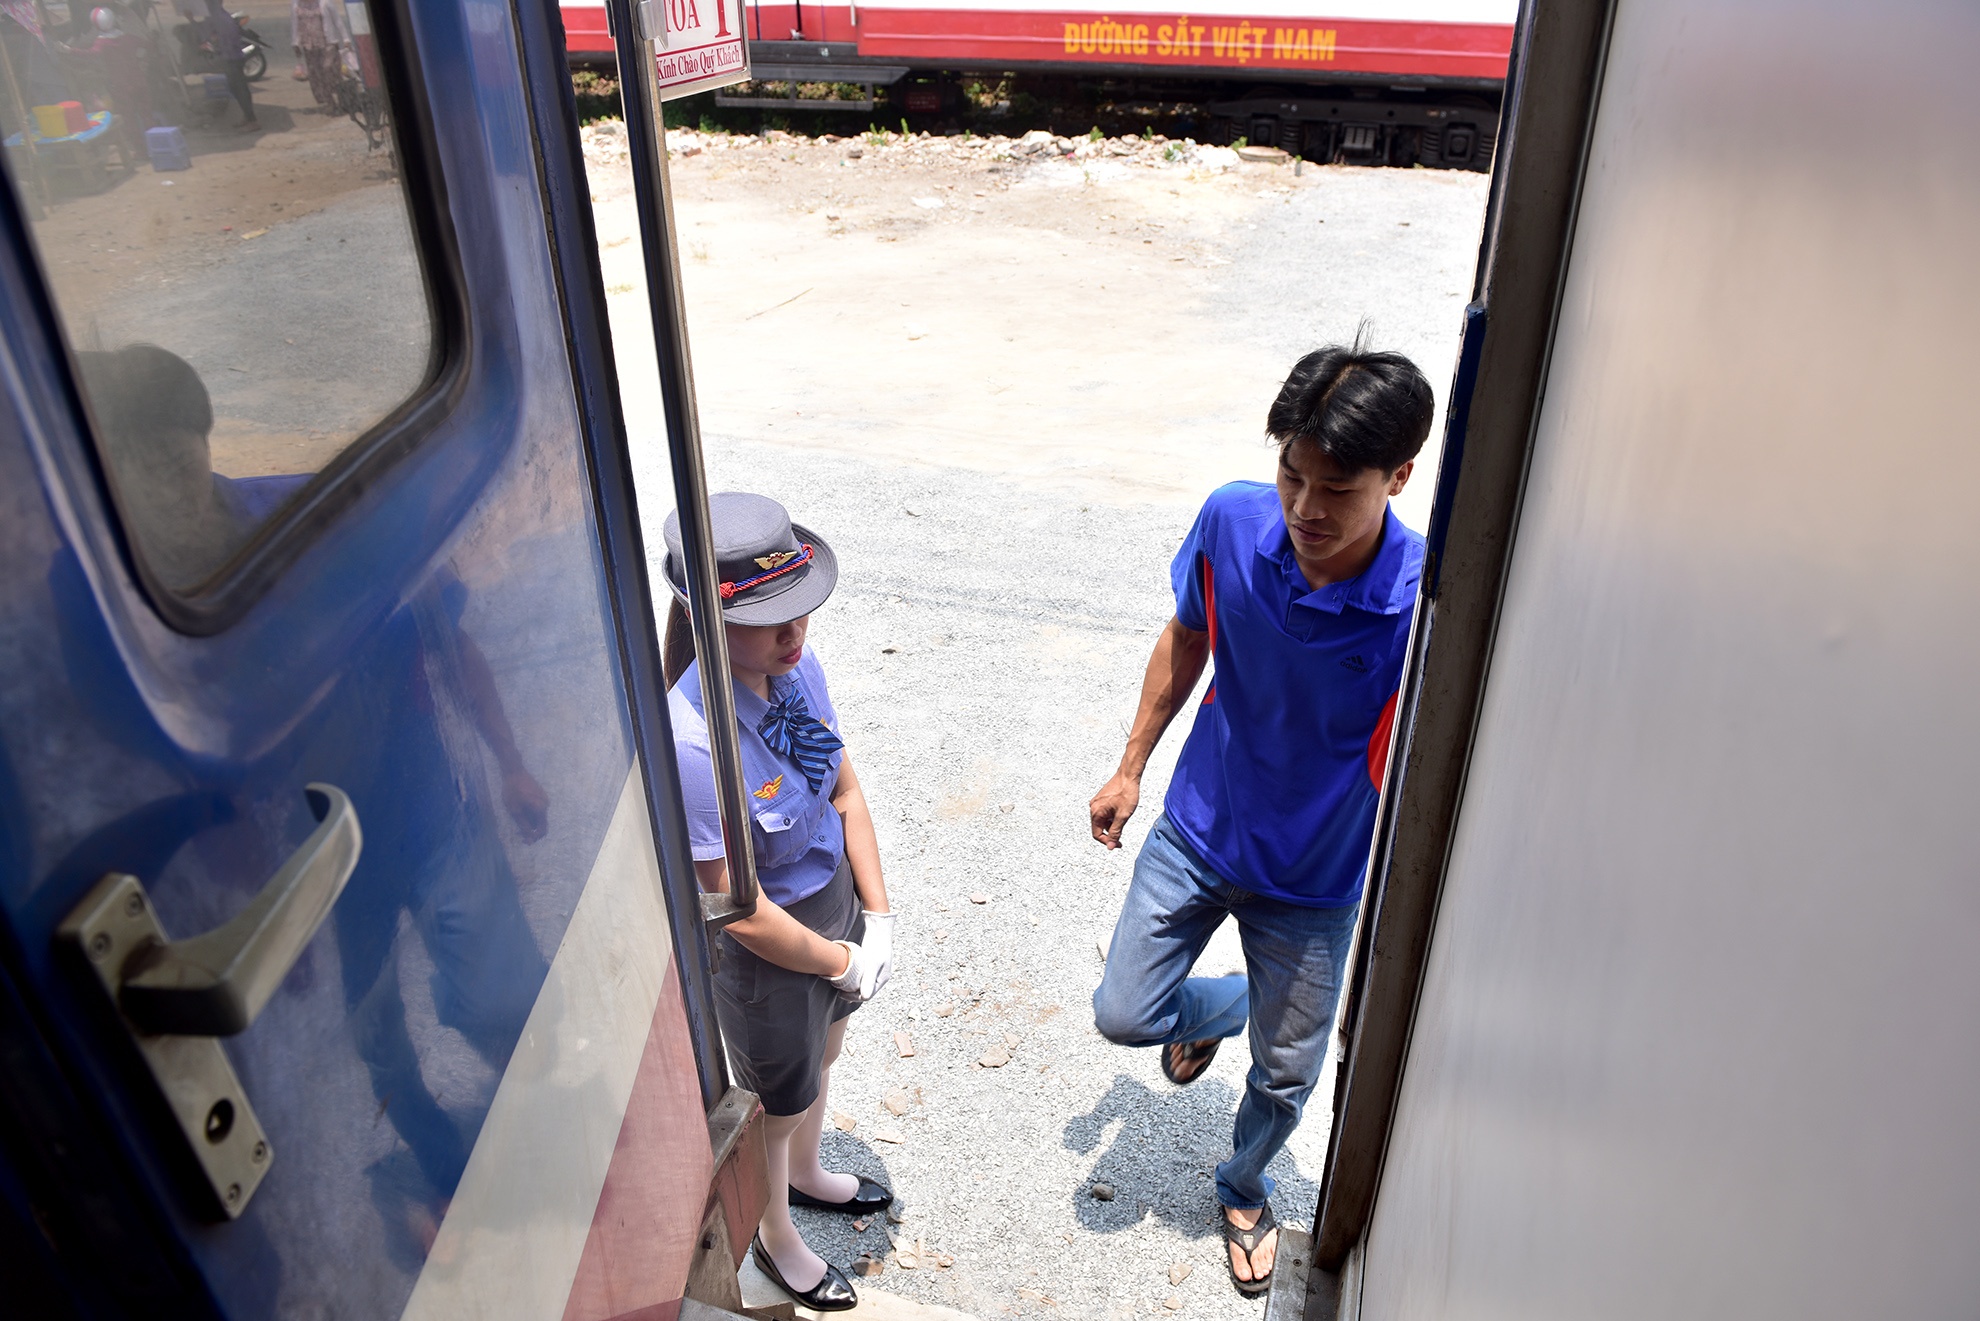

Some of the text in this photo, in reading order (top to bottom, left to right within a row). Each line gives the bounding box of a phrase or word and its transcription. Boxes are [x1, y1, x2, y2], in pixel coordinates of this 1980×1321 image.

[1064, 15, 1337, 63] ĐƯỜNG SẮT VIỆT NAM
[656, 45, 740, 80] Kính Chào Quý Khách
